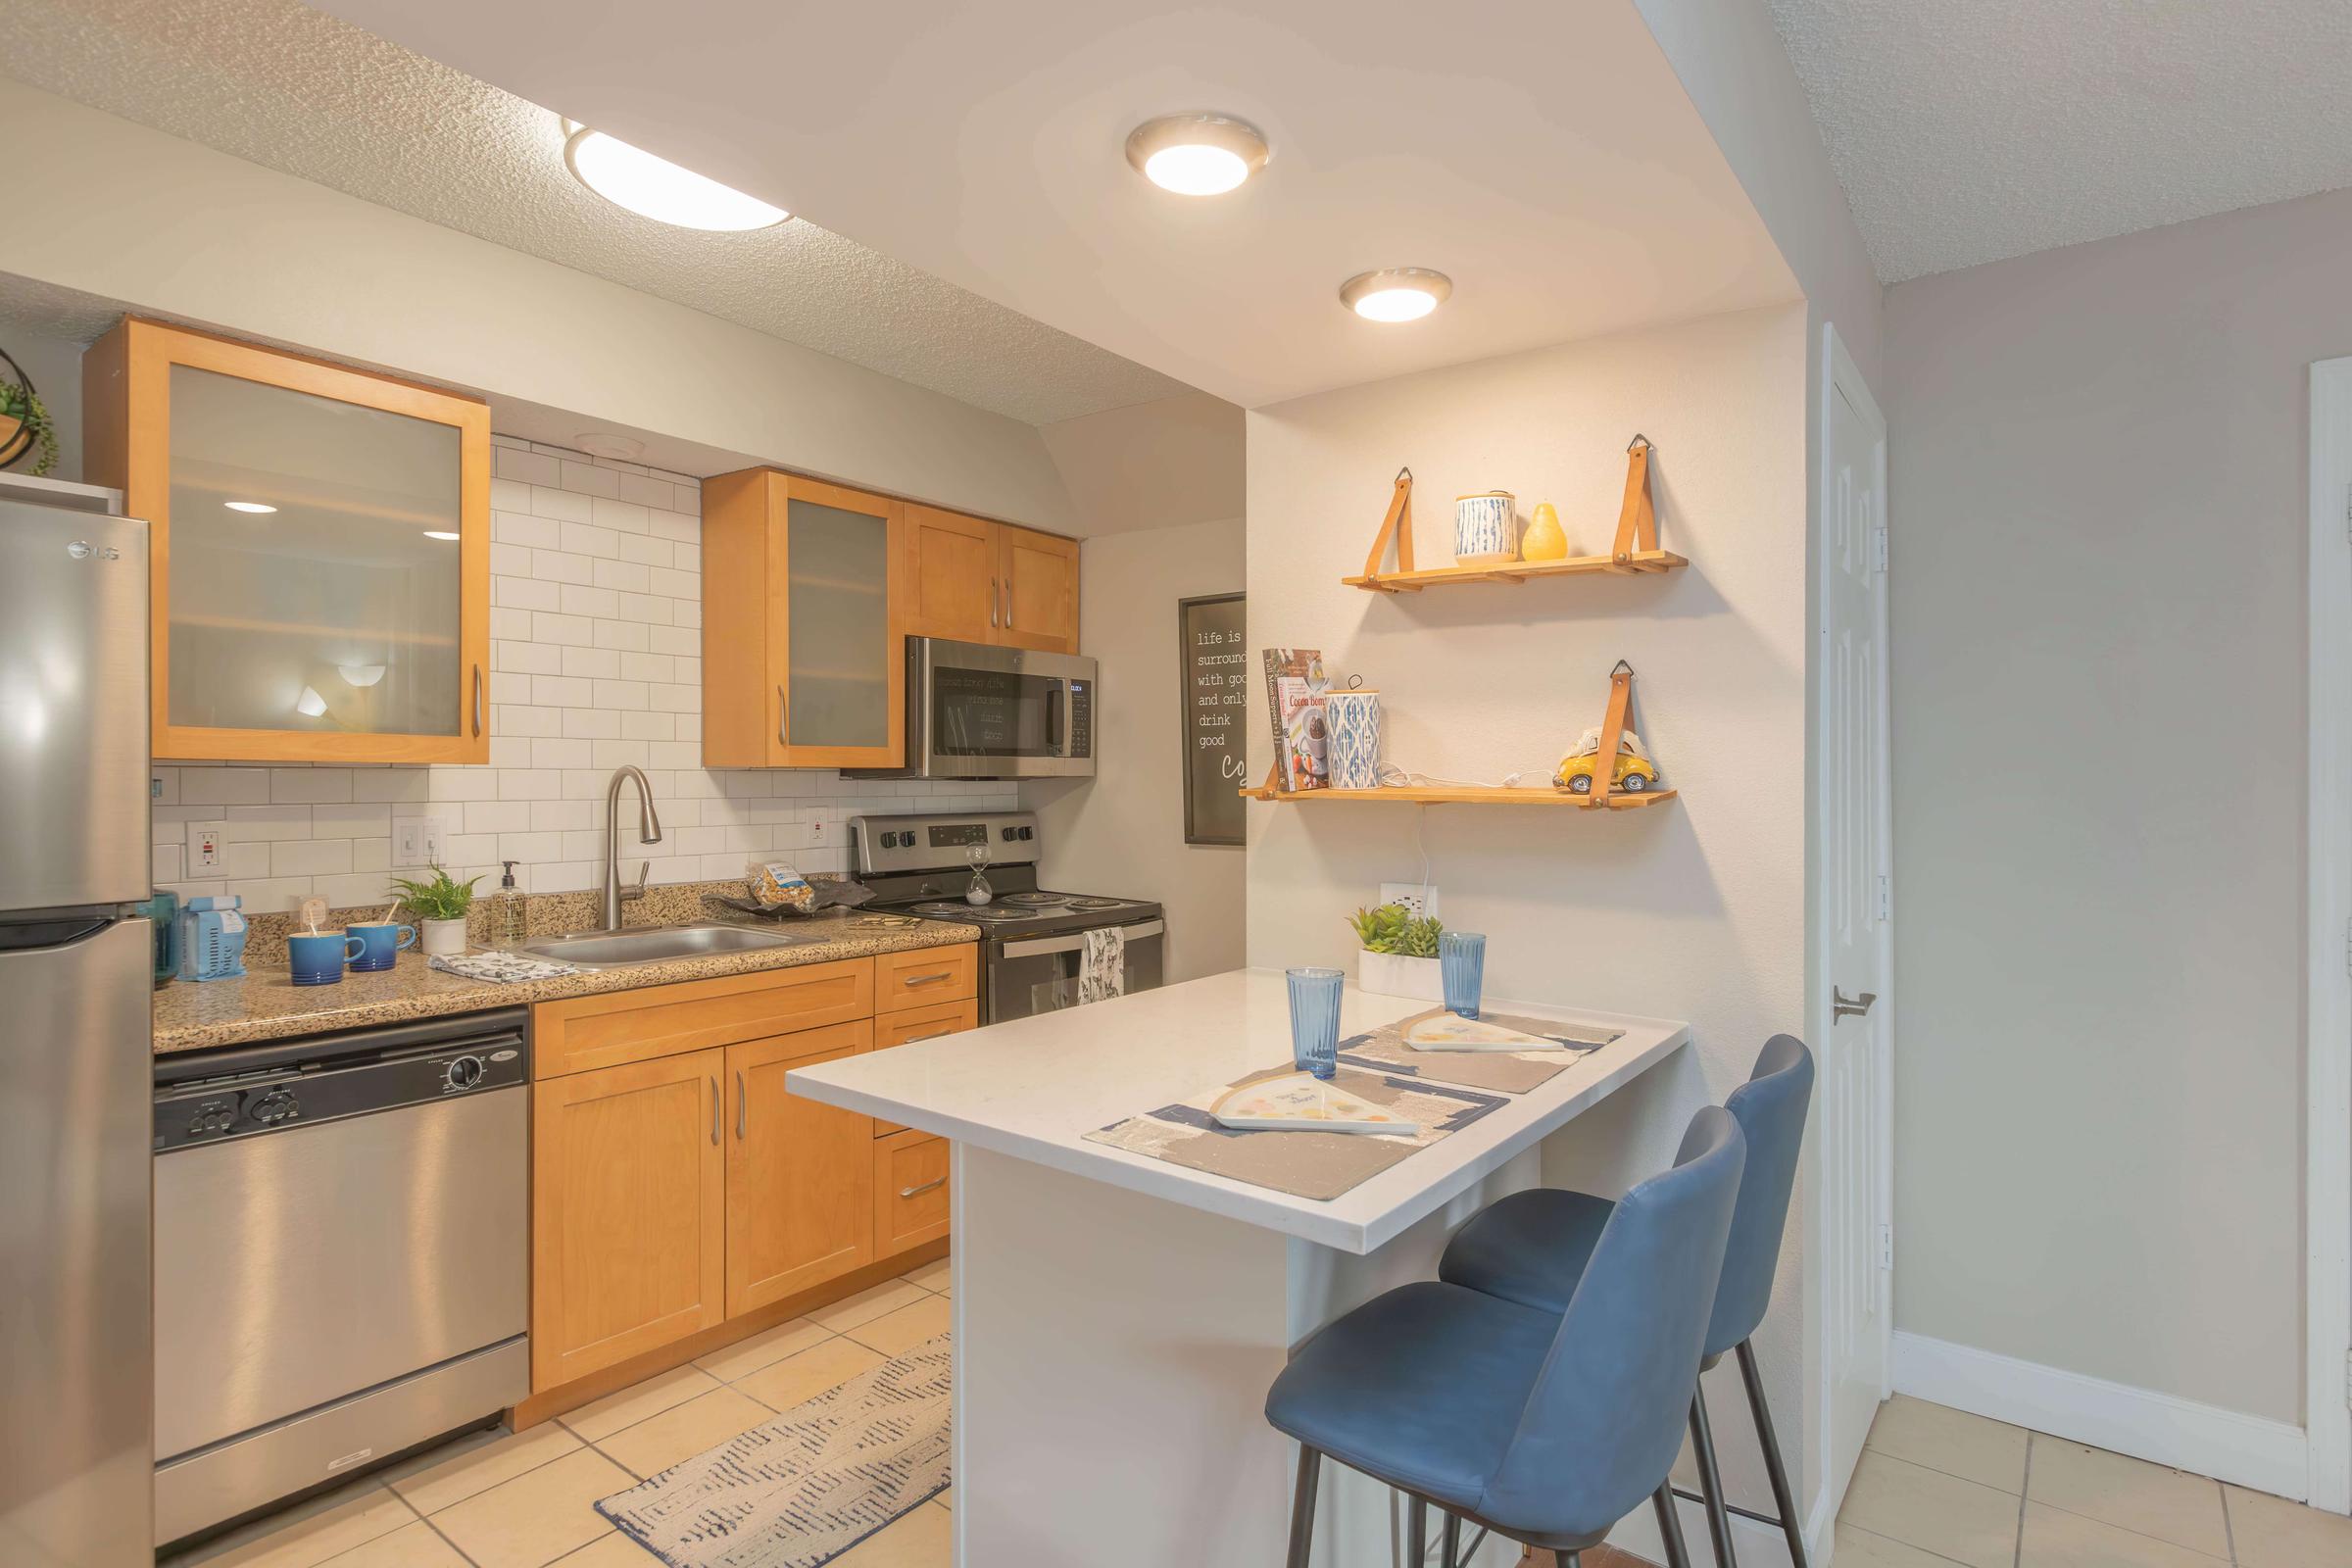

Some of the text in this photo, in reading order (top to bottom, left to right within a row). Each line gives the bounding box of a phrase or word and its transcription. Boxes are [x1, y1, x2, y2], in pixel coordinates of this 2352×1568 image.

[1198, 630, 1241, 645] life is
[1198, 673, 1223, 686] with
[1199, 692, 1247, 707] and only
[1290, 694, 1308, 707] Cocoa
[1199, 713, 1231, 726] drink
[1200, 734, 1225, 749] good
